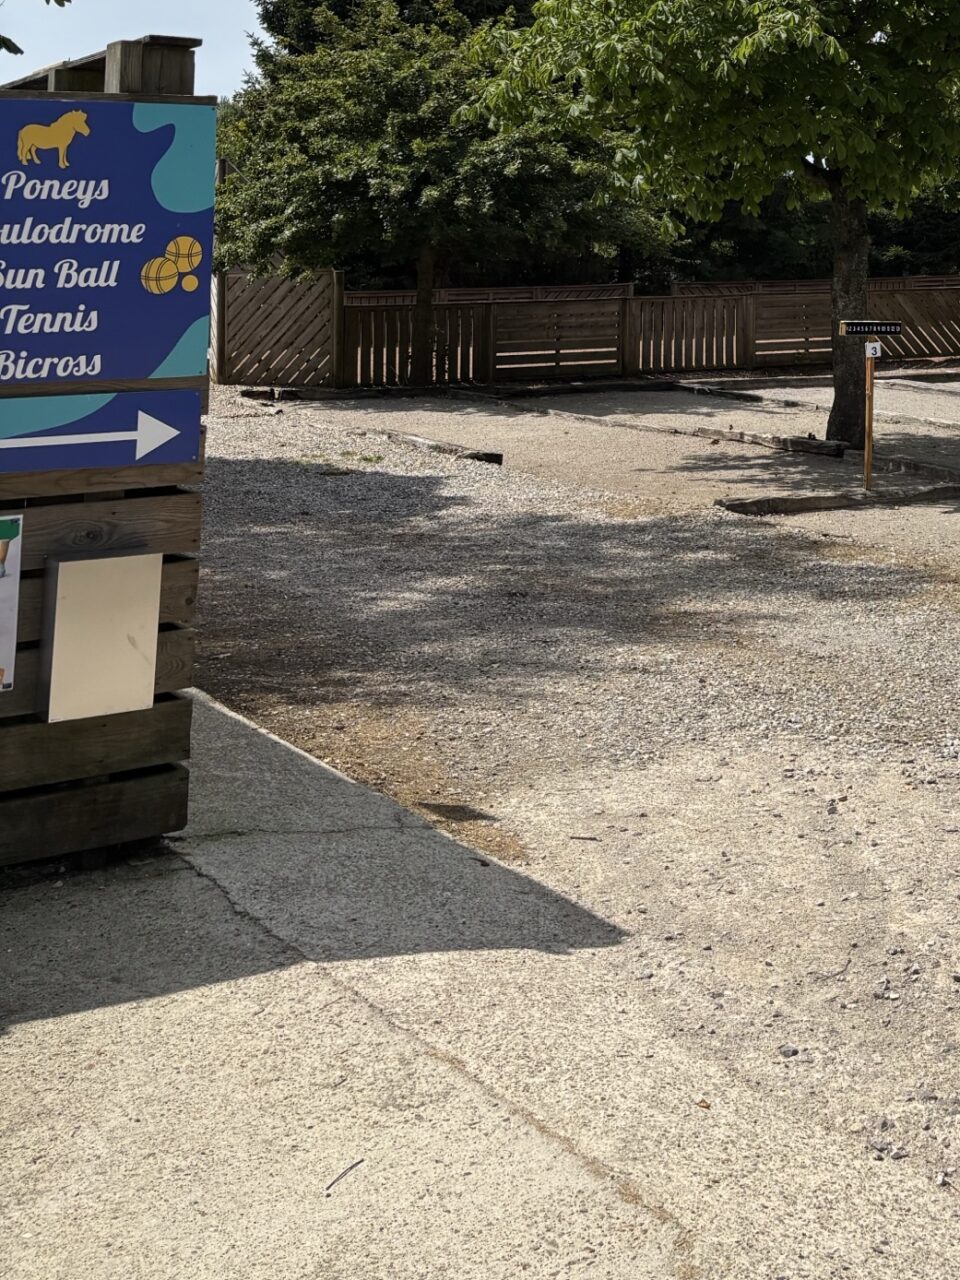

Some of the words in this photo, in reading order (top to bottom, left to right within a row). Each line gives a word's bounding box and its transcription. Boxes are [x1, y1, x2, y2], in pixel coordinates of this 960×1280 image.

[1, 170, 109, 208] Poneys
[0, 217, 146, 244] ulodrome
[53, 258, 120, 288] Ball
[0, 303, 98, 335] Tennis
[0, 350, 102, 380] Bicross
[871, 346, 878, 356] 3
